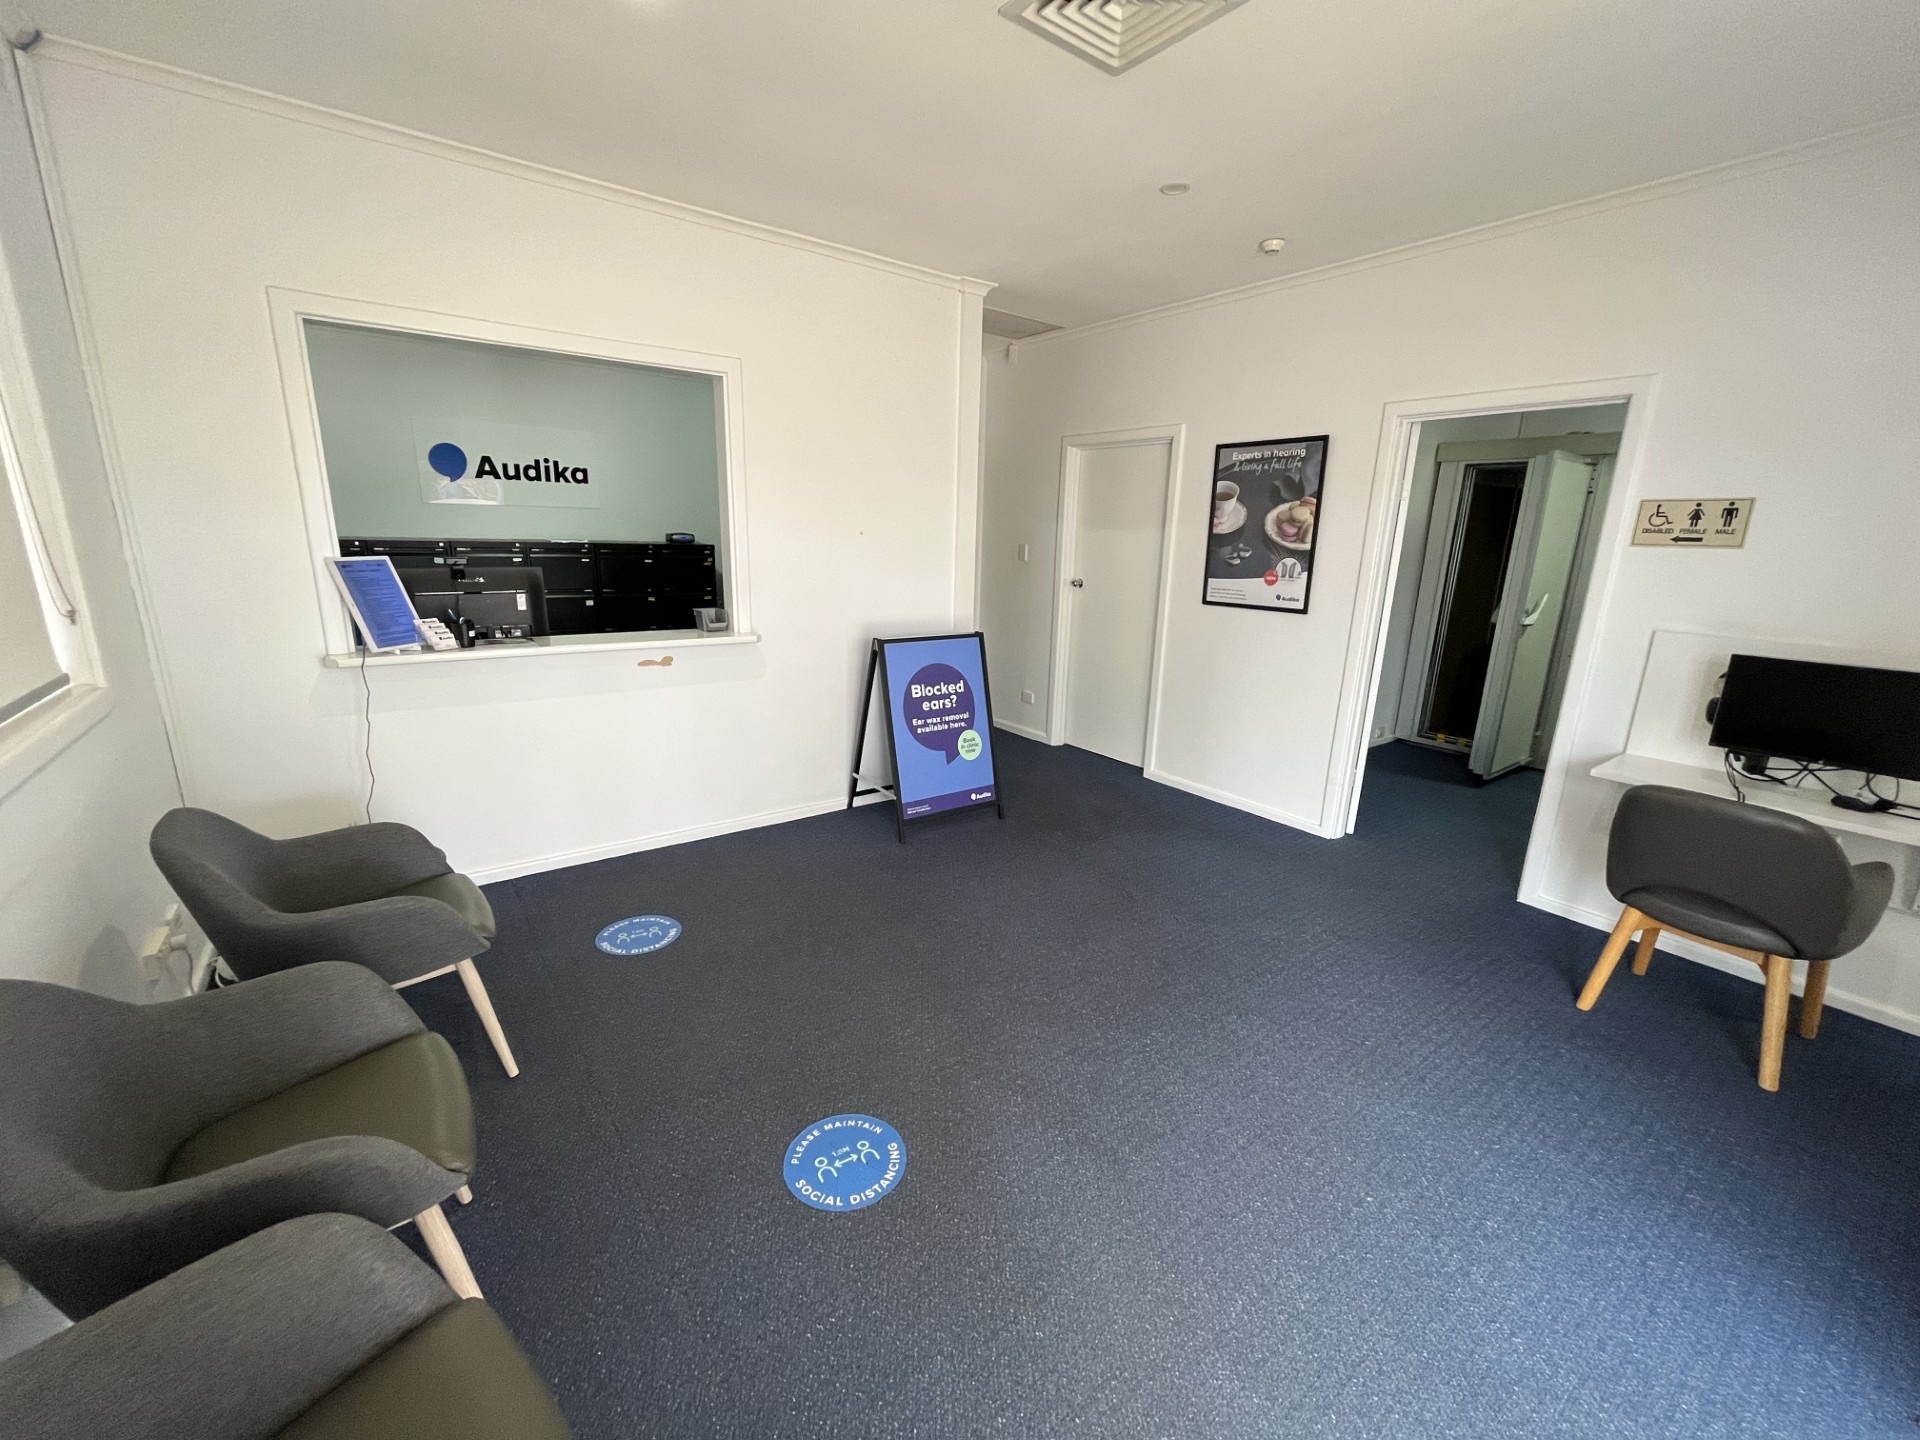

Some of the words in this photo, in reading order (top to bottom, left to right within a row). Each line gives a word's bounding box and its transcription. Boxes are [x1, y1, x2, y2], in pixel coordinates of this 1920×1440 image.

[1232, 451, 1262, 460] Experts
[1273, 448, 1306, 457] hearing
[475, 456, 589, 485] Audika
[911, 680, 964, 698] Blocked
[922, 694, 957, 711] ears?
[942, 712, 969, 722] removal
[917, 723, 948, 734] available
[630, 928, 677, 954] DISTANCING
[791, 1129, 821, 1164] PLEASE
[824, 1120, 883, 1134] MAINTAIN
[795, 1179, 844, 1206] SOCIAL
[850, 1142, 900, 1204] DISTANCING
